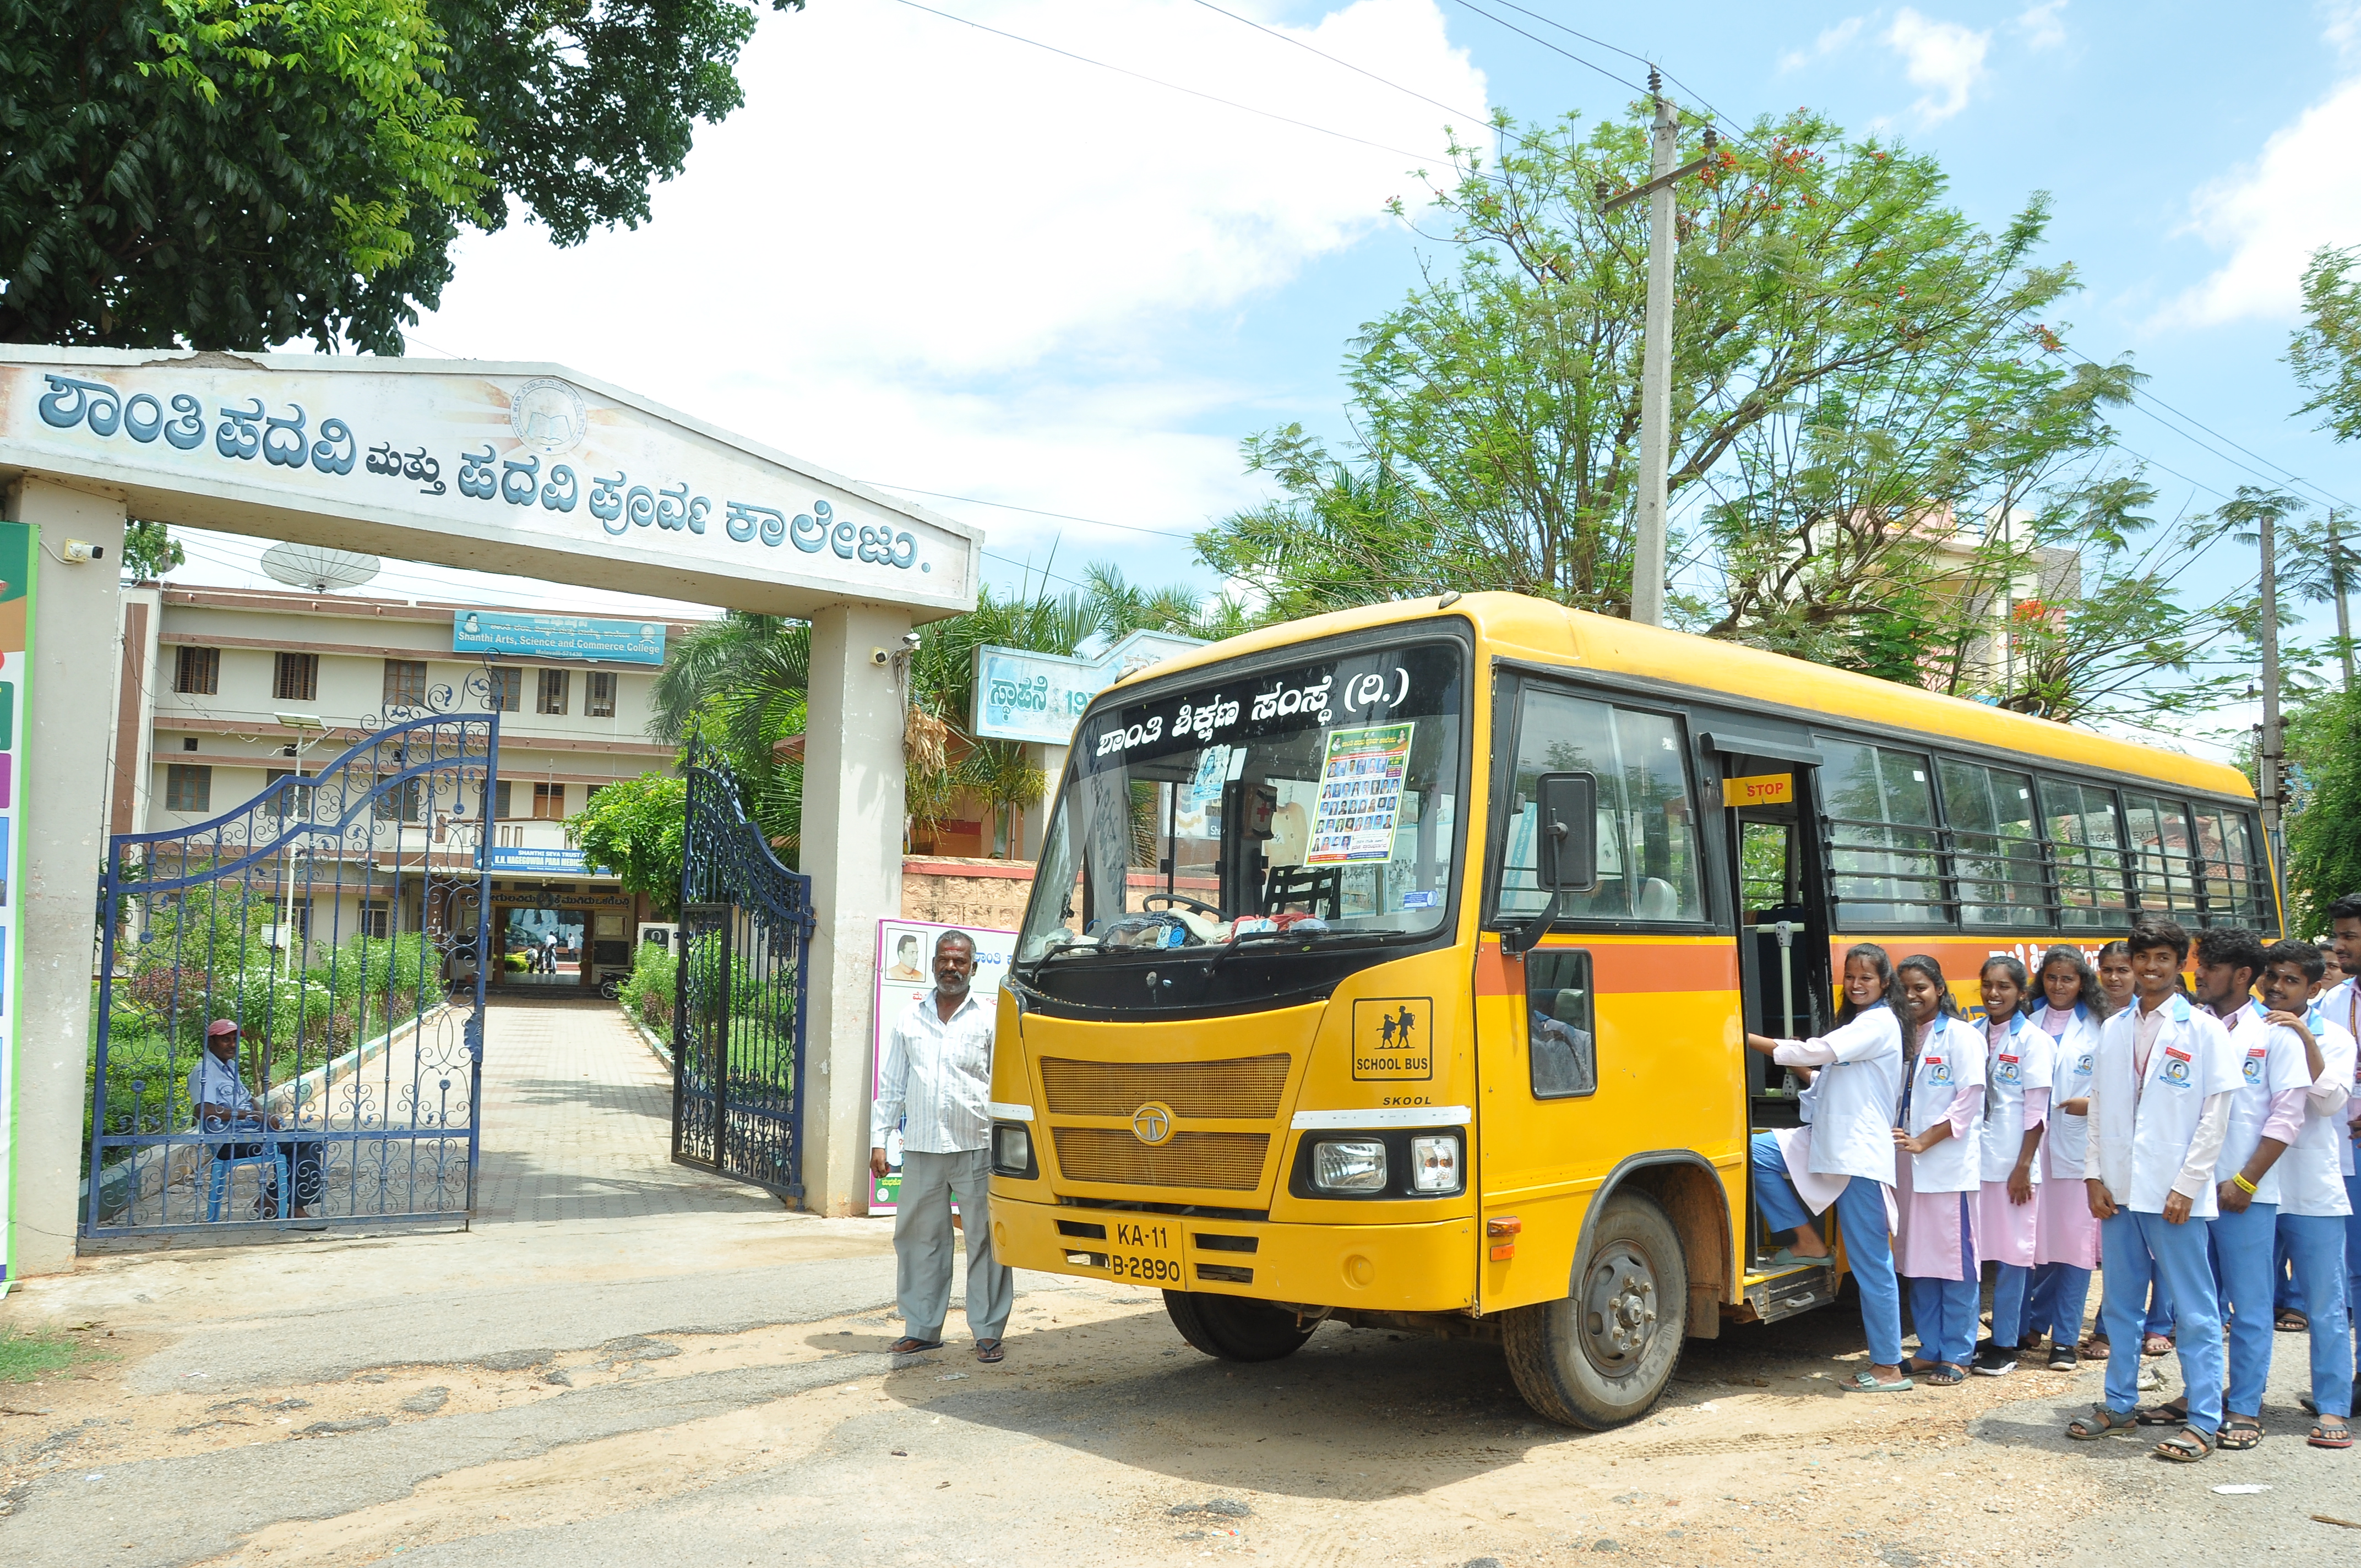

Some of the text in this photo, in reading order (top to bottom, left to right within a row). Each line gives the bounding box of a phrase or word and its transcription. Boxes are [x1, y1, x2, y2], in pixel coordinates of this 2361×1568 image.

[39, 374, 206, 449] ಶಾಂತಿ
[216, 398, 357, 476] ಪದವಿ
[366, 442, 447, 496] ಮತ್ತು
[458, 444, 578, 513] ಪದವಿ
[589, 470, 711, 536] ಪೂರ್ವ
[458, 632, 660, 654] Shanthi Arts, Science and Commerce College
[991, 676, 1048, 721] ಸ್ಥಾಪನೆ
[1096, 667, 1410, 756] ಶಾಂತಿ ಶಿಕ್ಷಣ ಸಂಸ್ಥೆ (ರಿ.)
[1747, 782, 1783, 797] STOP
[2133, 830, 2155, 840] EXIT
[545, 857, 561, 866] PARA
[1357, 1058, 1428, 1070] SCHOOL BUS
[1383, 1096, 1432, 1106] SKOOL
[1117, 1223, 1167, 1249] KA-11
[1112, 1255, 1180, 1282] B-2890
